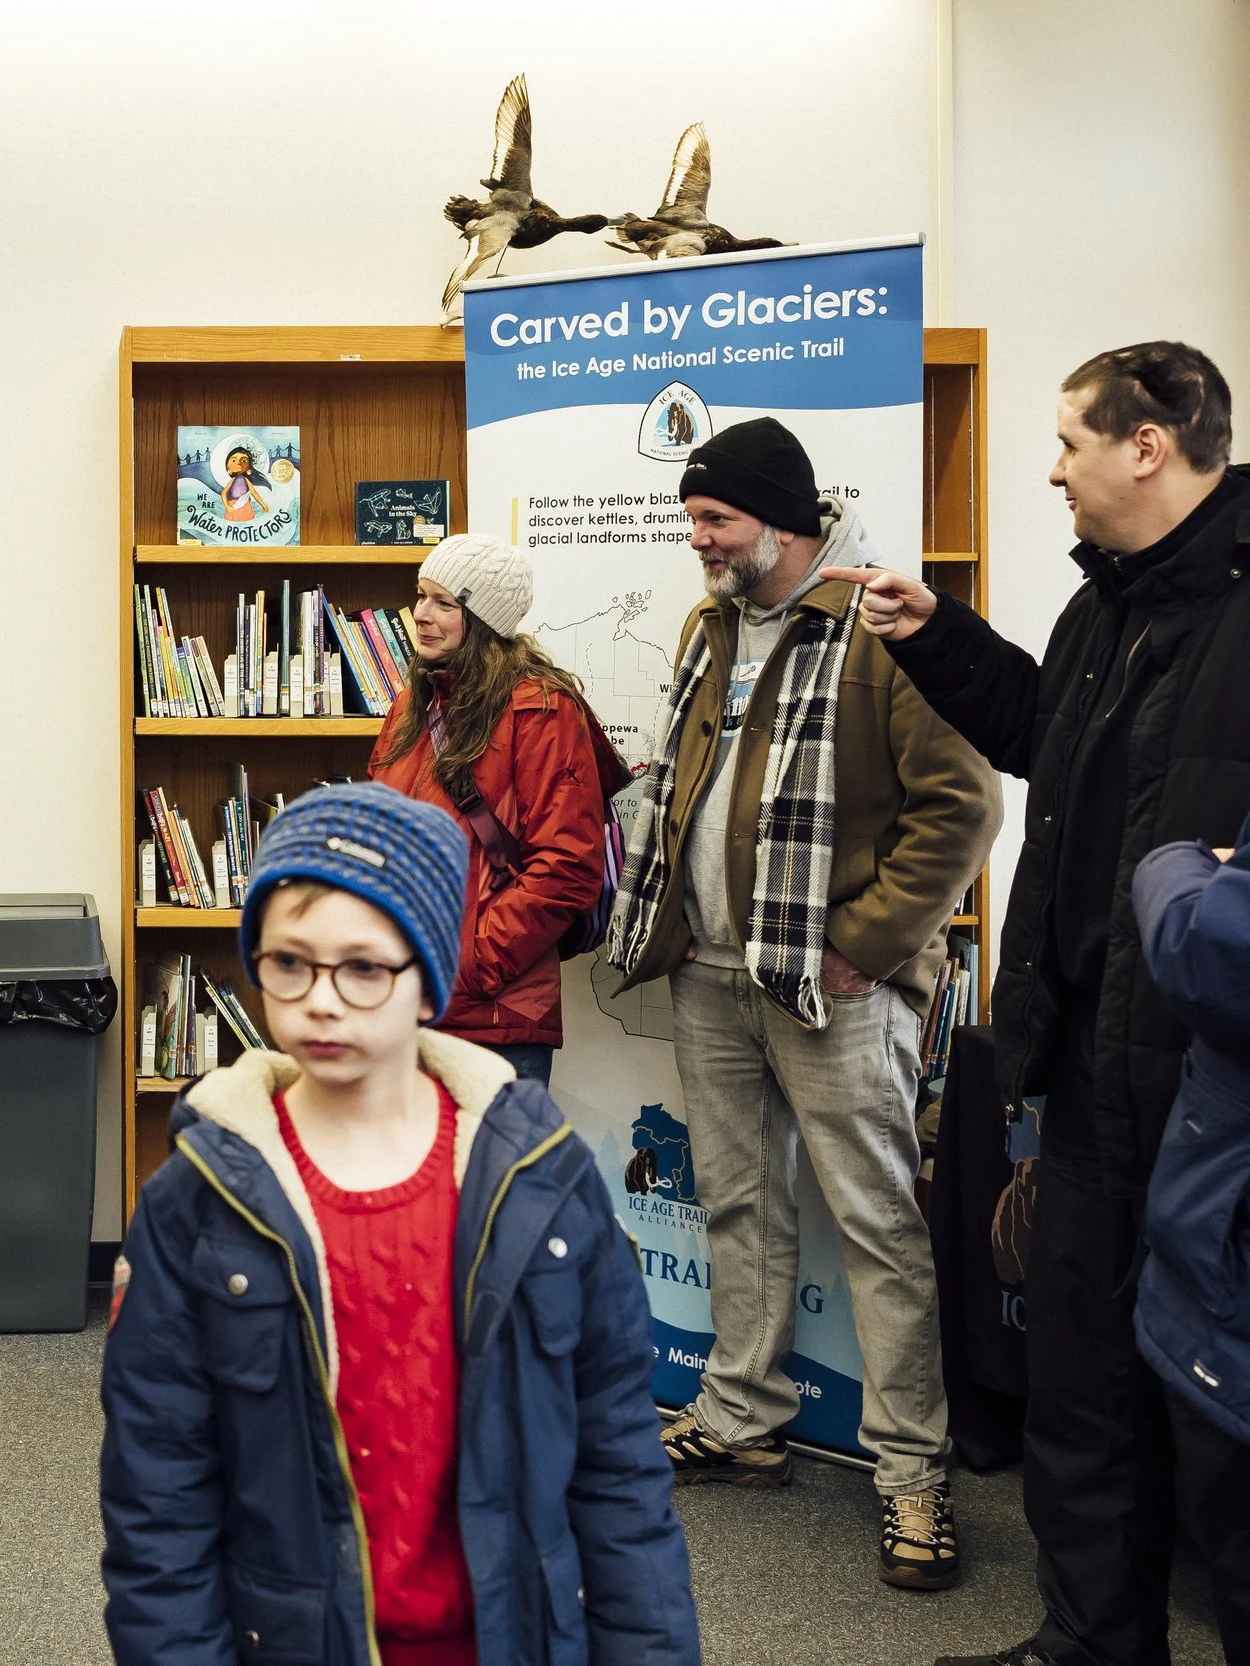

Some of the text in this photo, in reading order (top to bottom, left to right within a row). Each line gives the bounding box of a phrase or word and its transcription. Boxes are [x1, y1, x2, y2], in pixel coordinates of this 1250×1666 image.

[490, 284, 888, 347] Carved by Glaciers:
[517, 337, 844, 380] the Ice Age National Scenic Trail
[658, 390, 696, 405] ICE AGE
[650, 448, 672, 457] NATIONAL
[529, 496, 569, 509] Follow
[573, 495, 594, 507] the
[599, 493, 645, 509] yellow
[650, 492, 679, 506] blaz
[845, 486, 860, 498] to
[187, 505, 292, 542] Water PROTECTORS
[529, 514, 584, 527] discover
[588, 512, 638, 526] kettles,
[528, 530, 692, 547] glacial landforms shape
[602, 725, 638, 734] ppewa
[611, 735, 625, 745] be
[628, 799, 637, 807] to
[629, 1196, 647, 1212] ICE
[651, 1201, 674, 1217] AGE
[639, 1214, 702, 1233] ALLIANCE
[640, 1247, 710, 1290] TRAI
[1001, 1290, 1027, 1331] IC
[668, 1347, 708, 1370] Main
